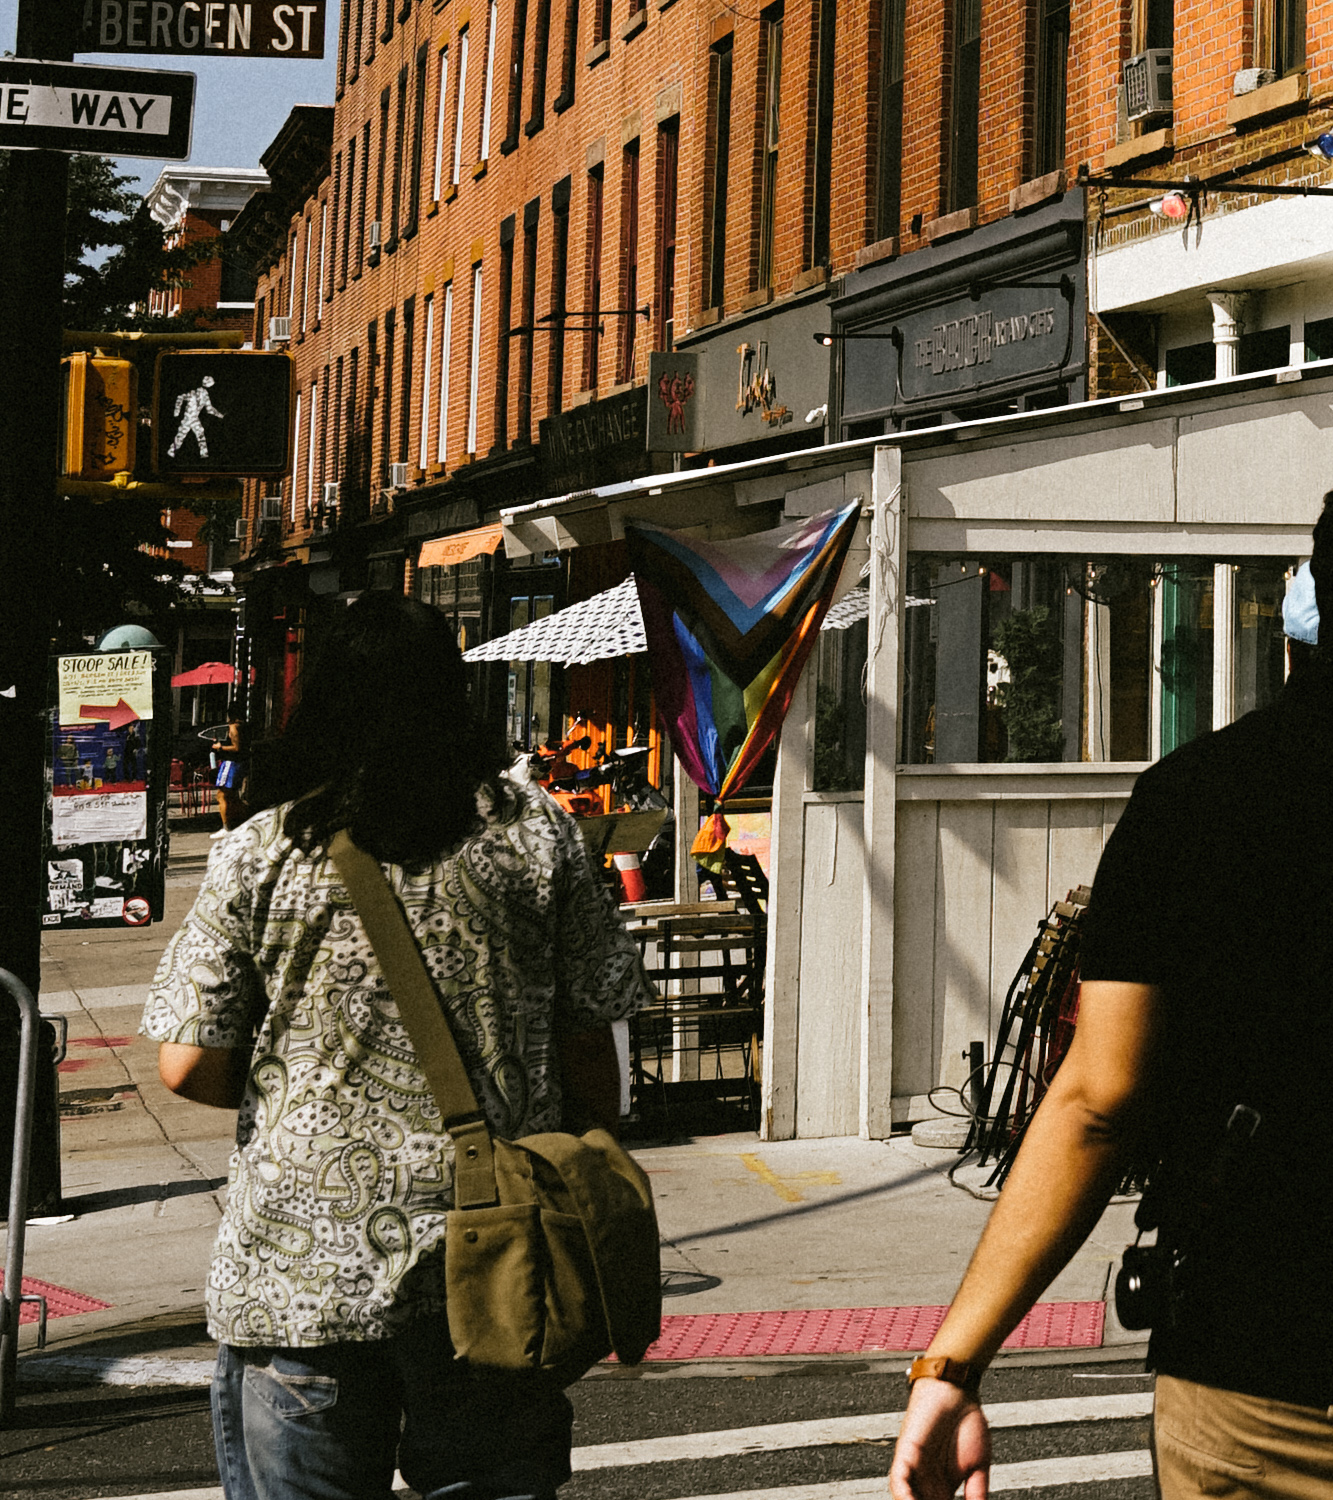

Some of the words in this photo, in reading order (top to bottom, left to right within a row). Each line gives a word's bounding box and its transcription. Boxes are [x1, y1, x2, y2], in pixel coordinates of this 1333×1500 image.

[100, 0, 251, 50] BERGEN
[271, 4, 317, 51] ST
[71, 92, 155, 129] WAY
[576, 402, 638, 452] EXCHANGE
[62, 658, 104, 673] STOOP
[107, 654, 147, 671] SALE!
